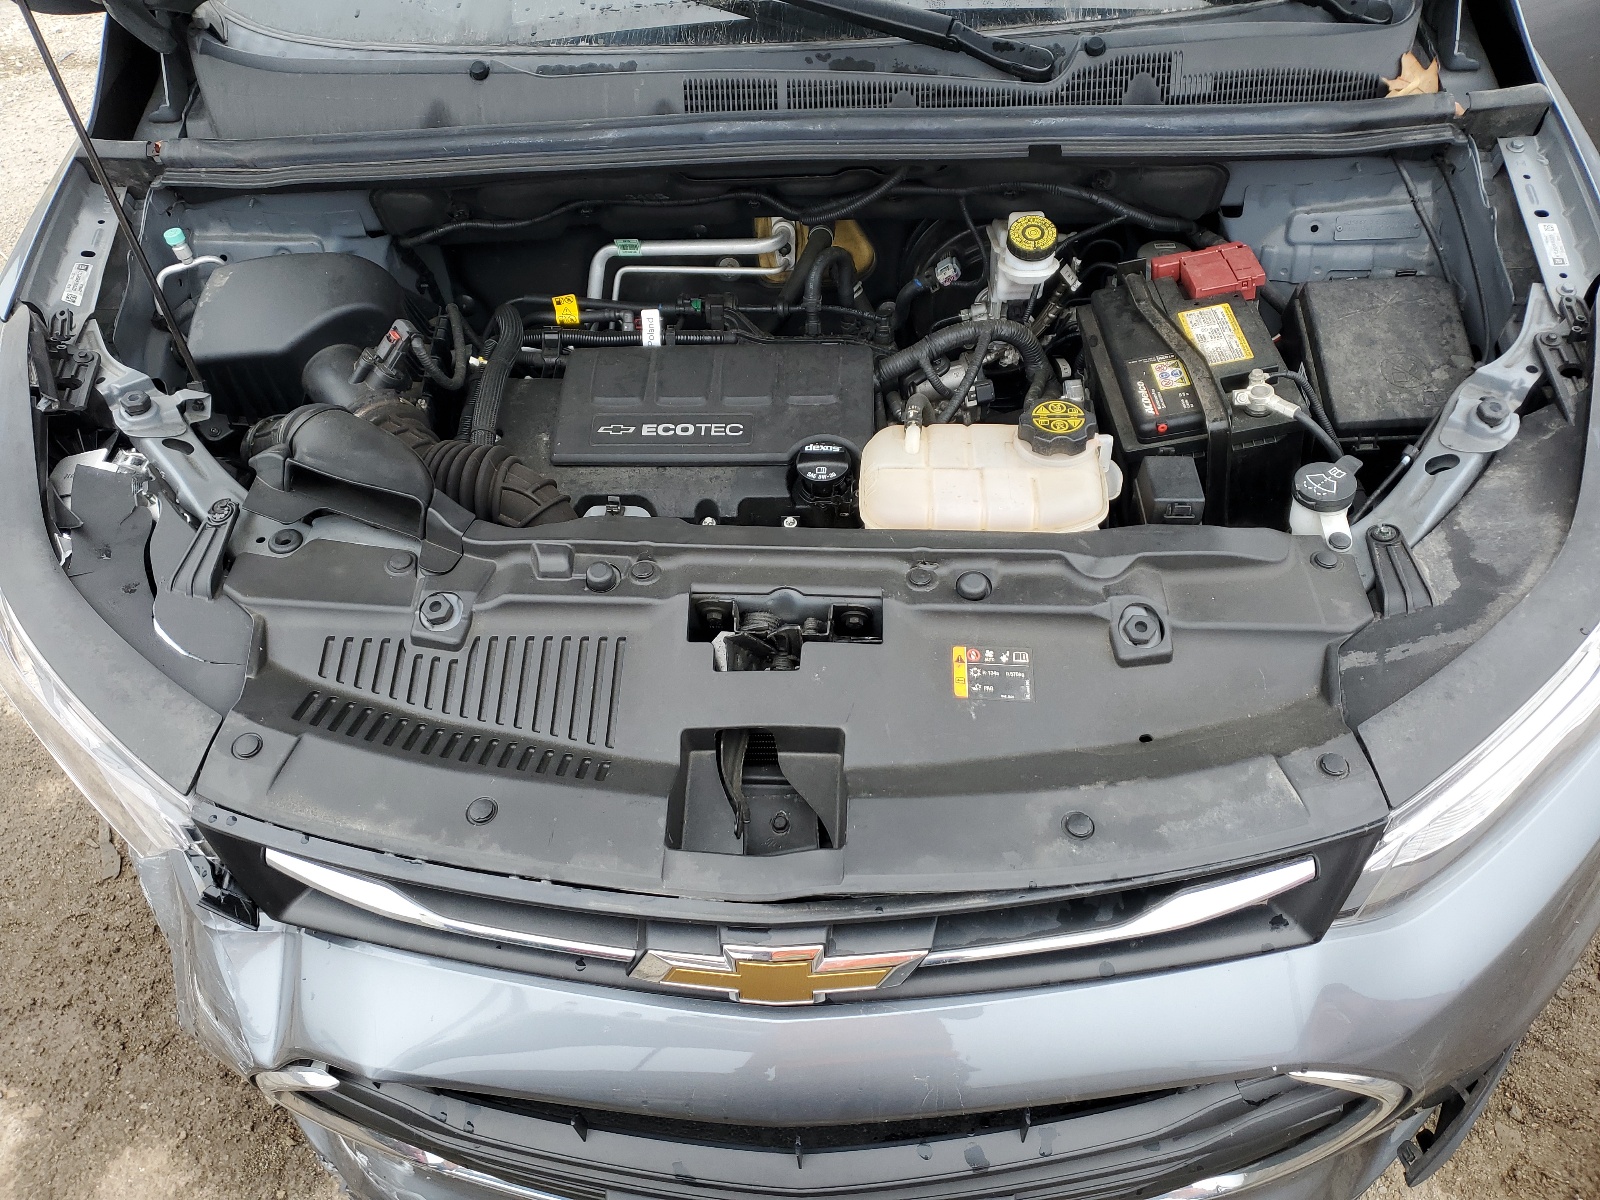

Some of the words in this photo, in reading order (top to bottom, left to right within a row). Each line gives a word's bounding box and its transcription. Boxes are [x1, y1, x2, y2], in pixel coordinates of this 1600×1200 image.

[646, 317, 655, 346] Poland
[1136, 380, 1156, 415] ACDelco
[641, 423, 744, 436] ECOTEC
[804, 443, 843, 452] dexos
